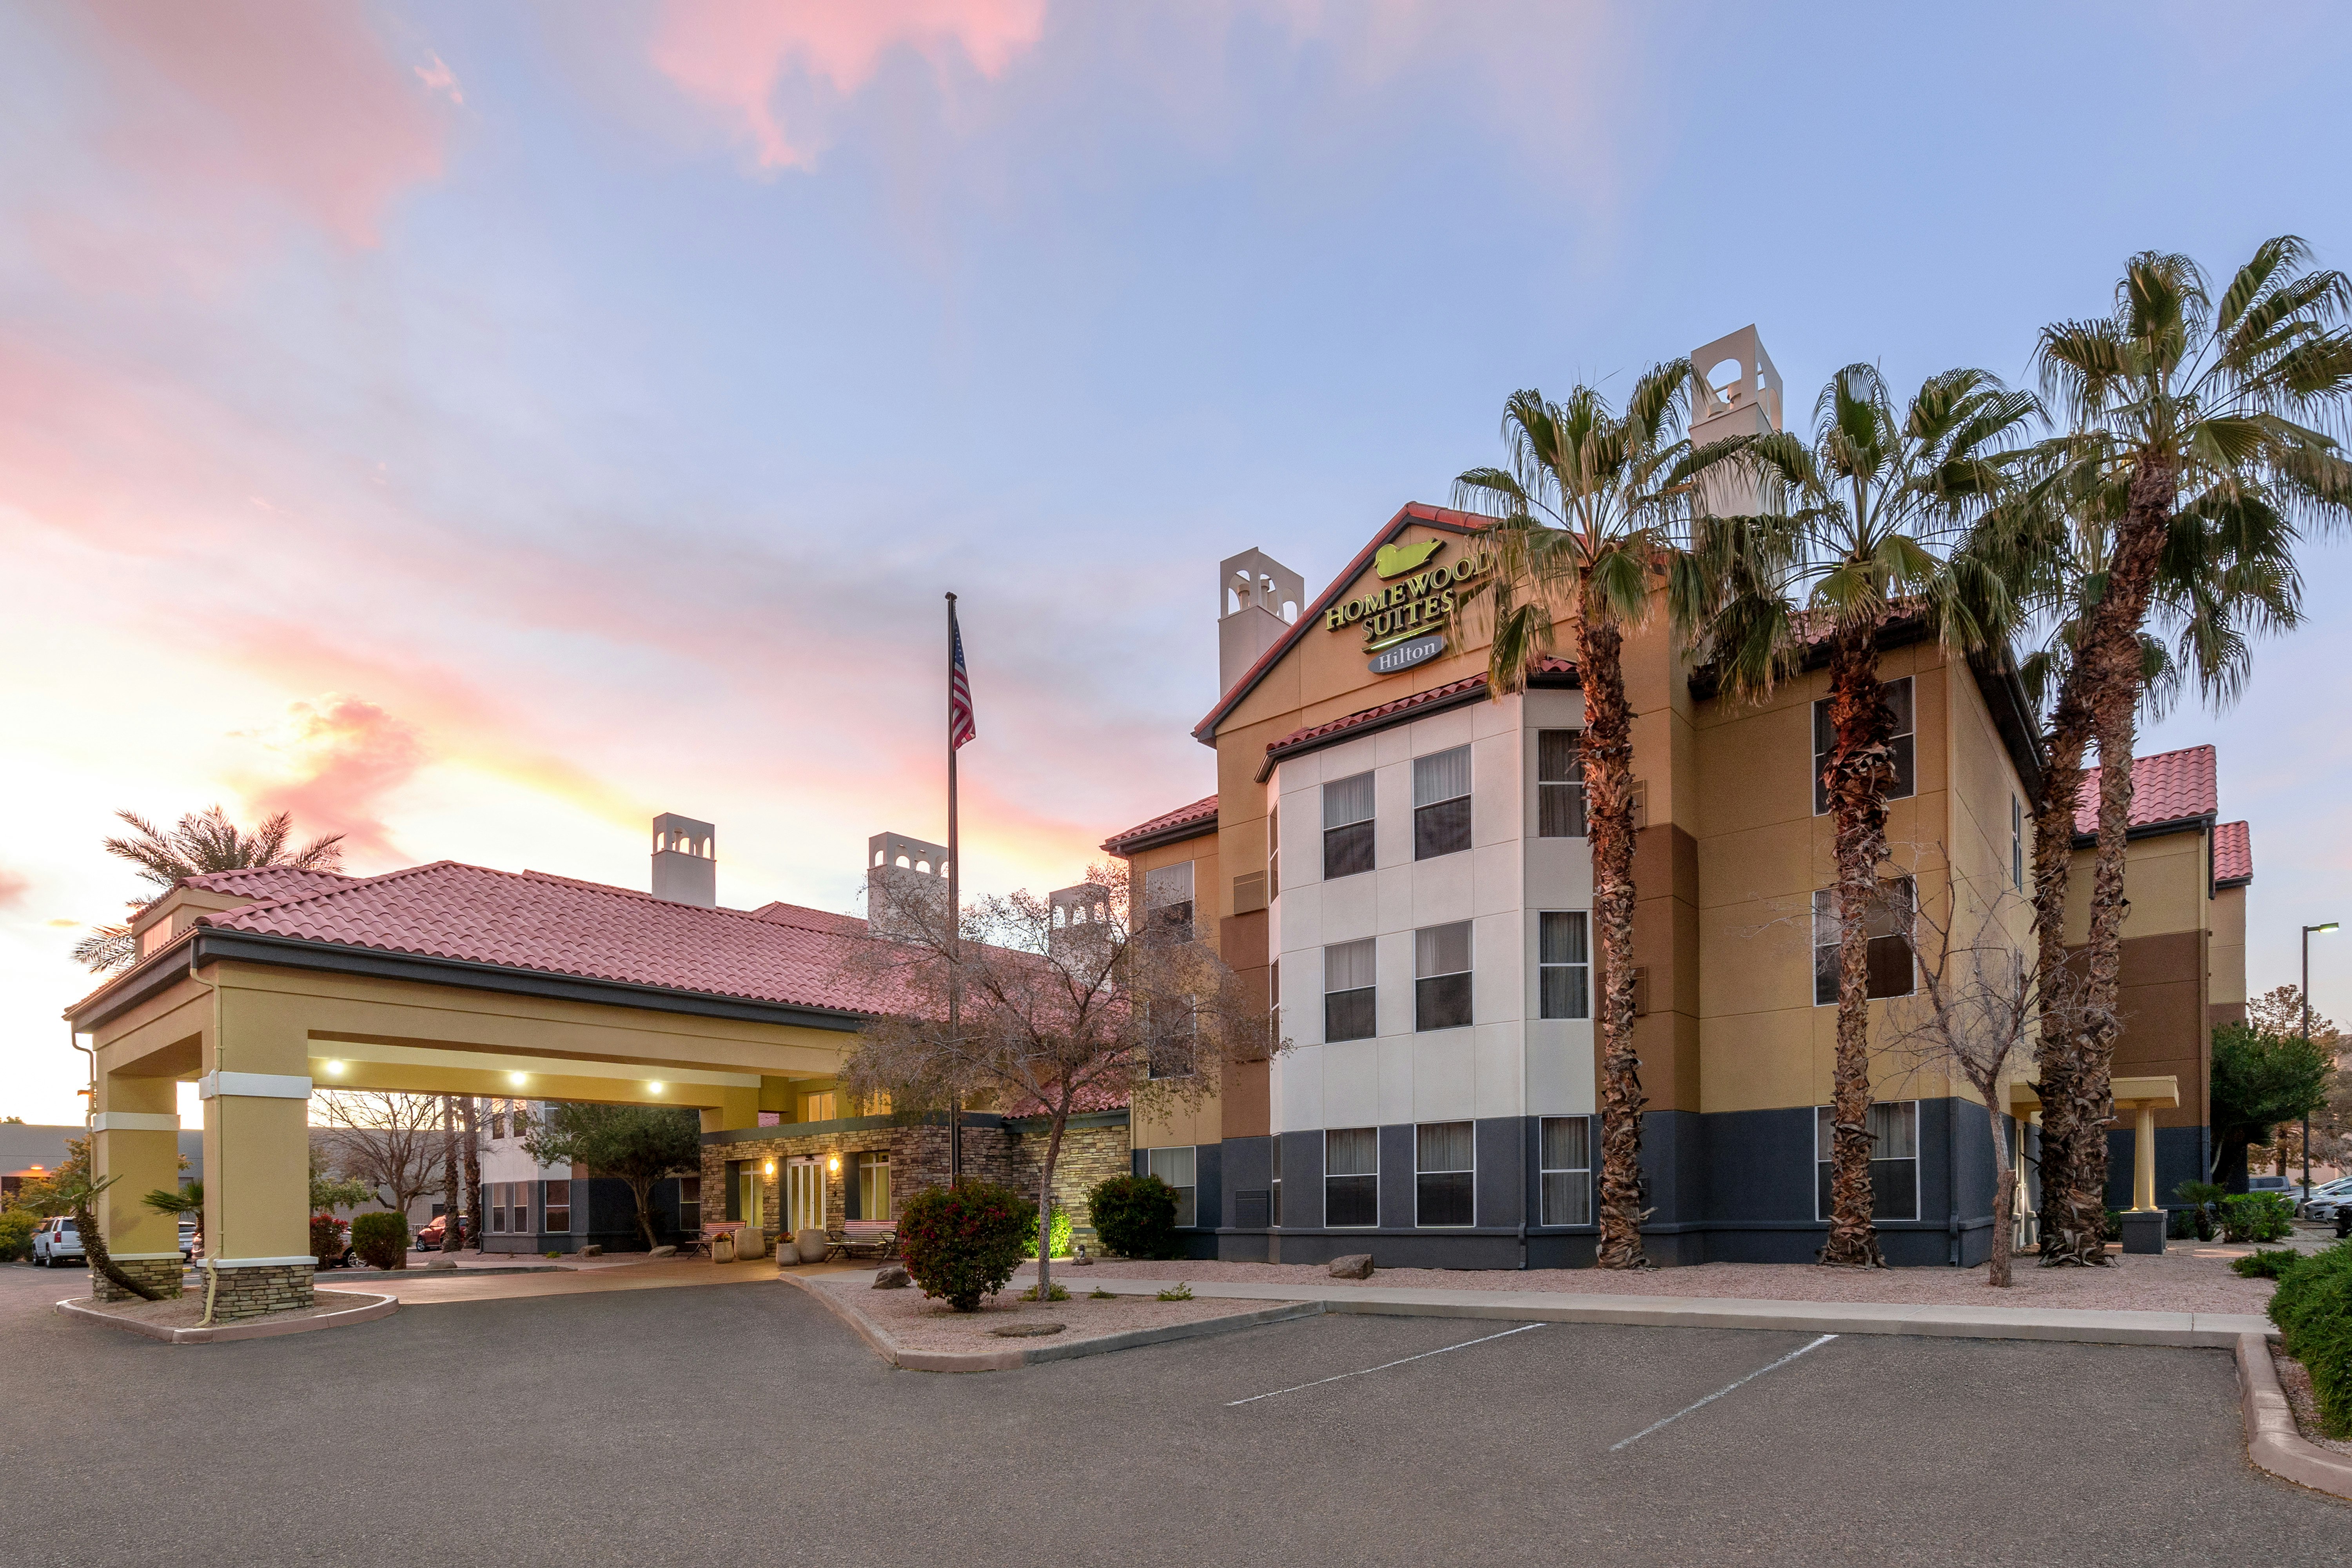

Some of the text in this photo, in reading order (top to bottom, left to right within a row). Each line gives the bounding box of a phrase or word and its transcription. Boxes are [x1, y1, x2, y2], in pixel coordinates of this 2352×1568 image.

[1325, 550, 1495, 630] HOMEWOOD
[1361, 588, 1454, 641] SUITES
[1379, 642, 1436, 671] Hilton
